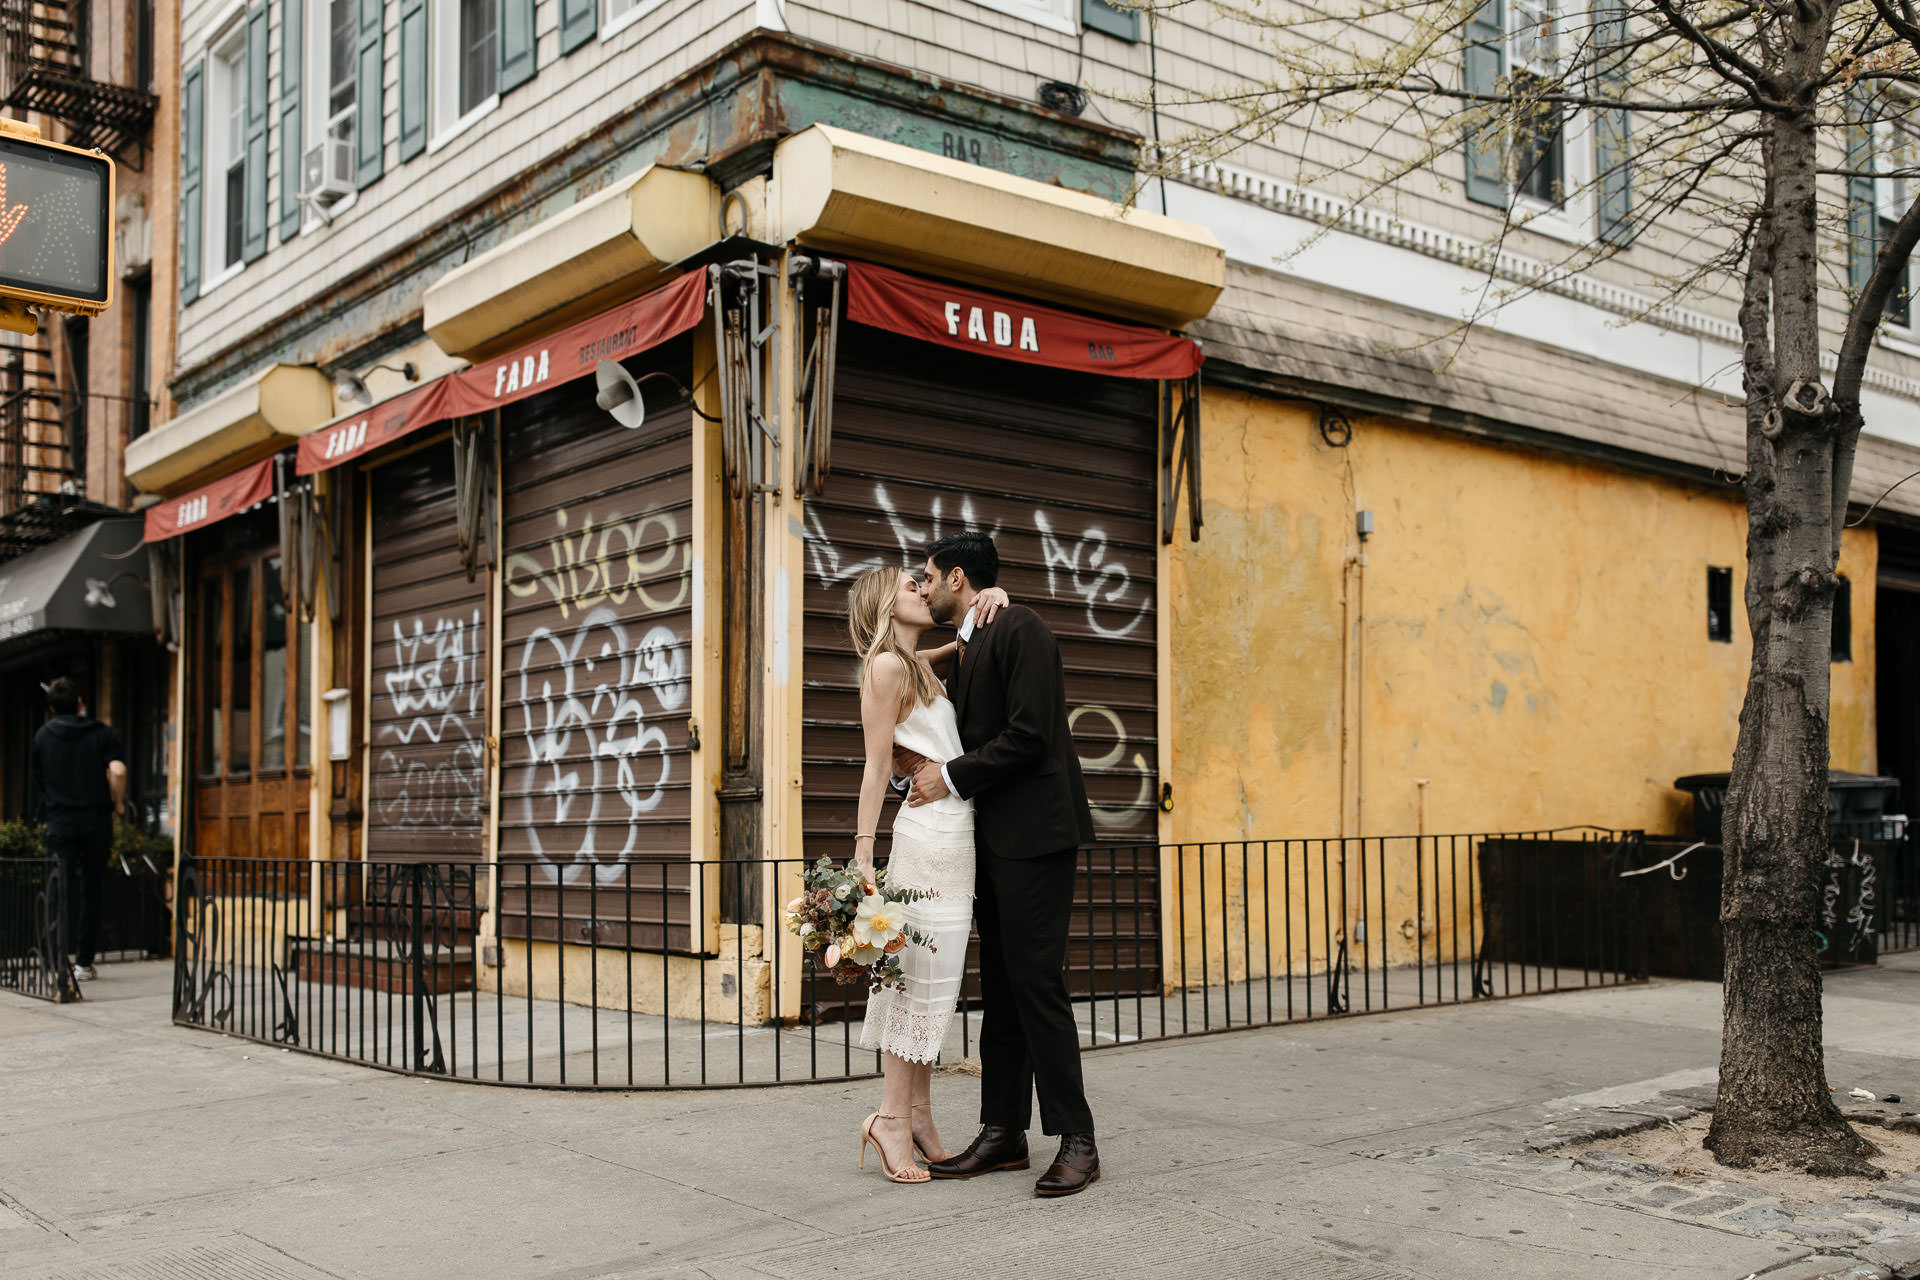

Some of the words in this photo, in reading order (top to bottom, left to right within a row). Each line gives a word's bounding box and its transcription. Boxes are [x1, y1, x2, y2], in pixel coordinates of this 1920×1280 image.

[943, 131, 981, 166] BAR
[945, 301, 1040, 353] FADA
[1088, 342, 1117, 362] BAR
[495, 349, 549, 398] FADA
[578, 325, 638, 366] RESTAURANT
[325, 419, 368, 460] FADA
